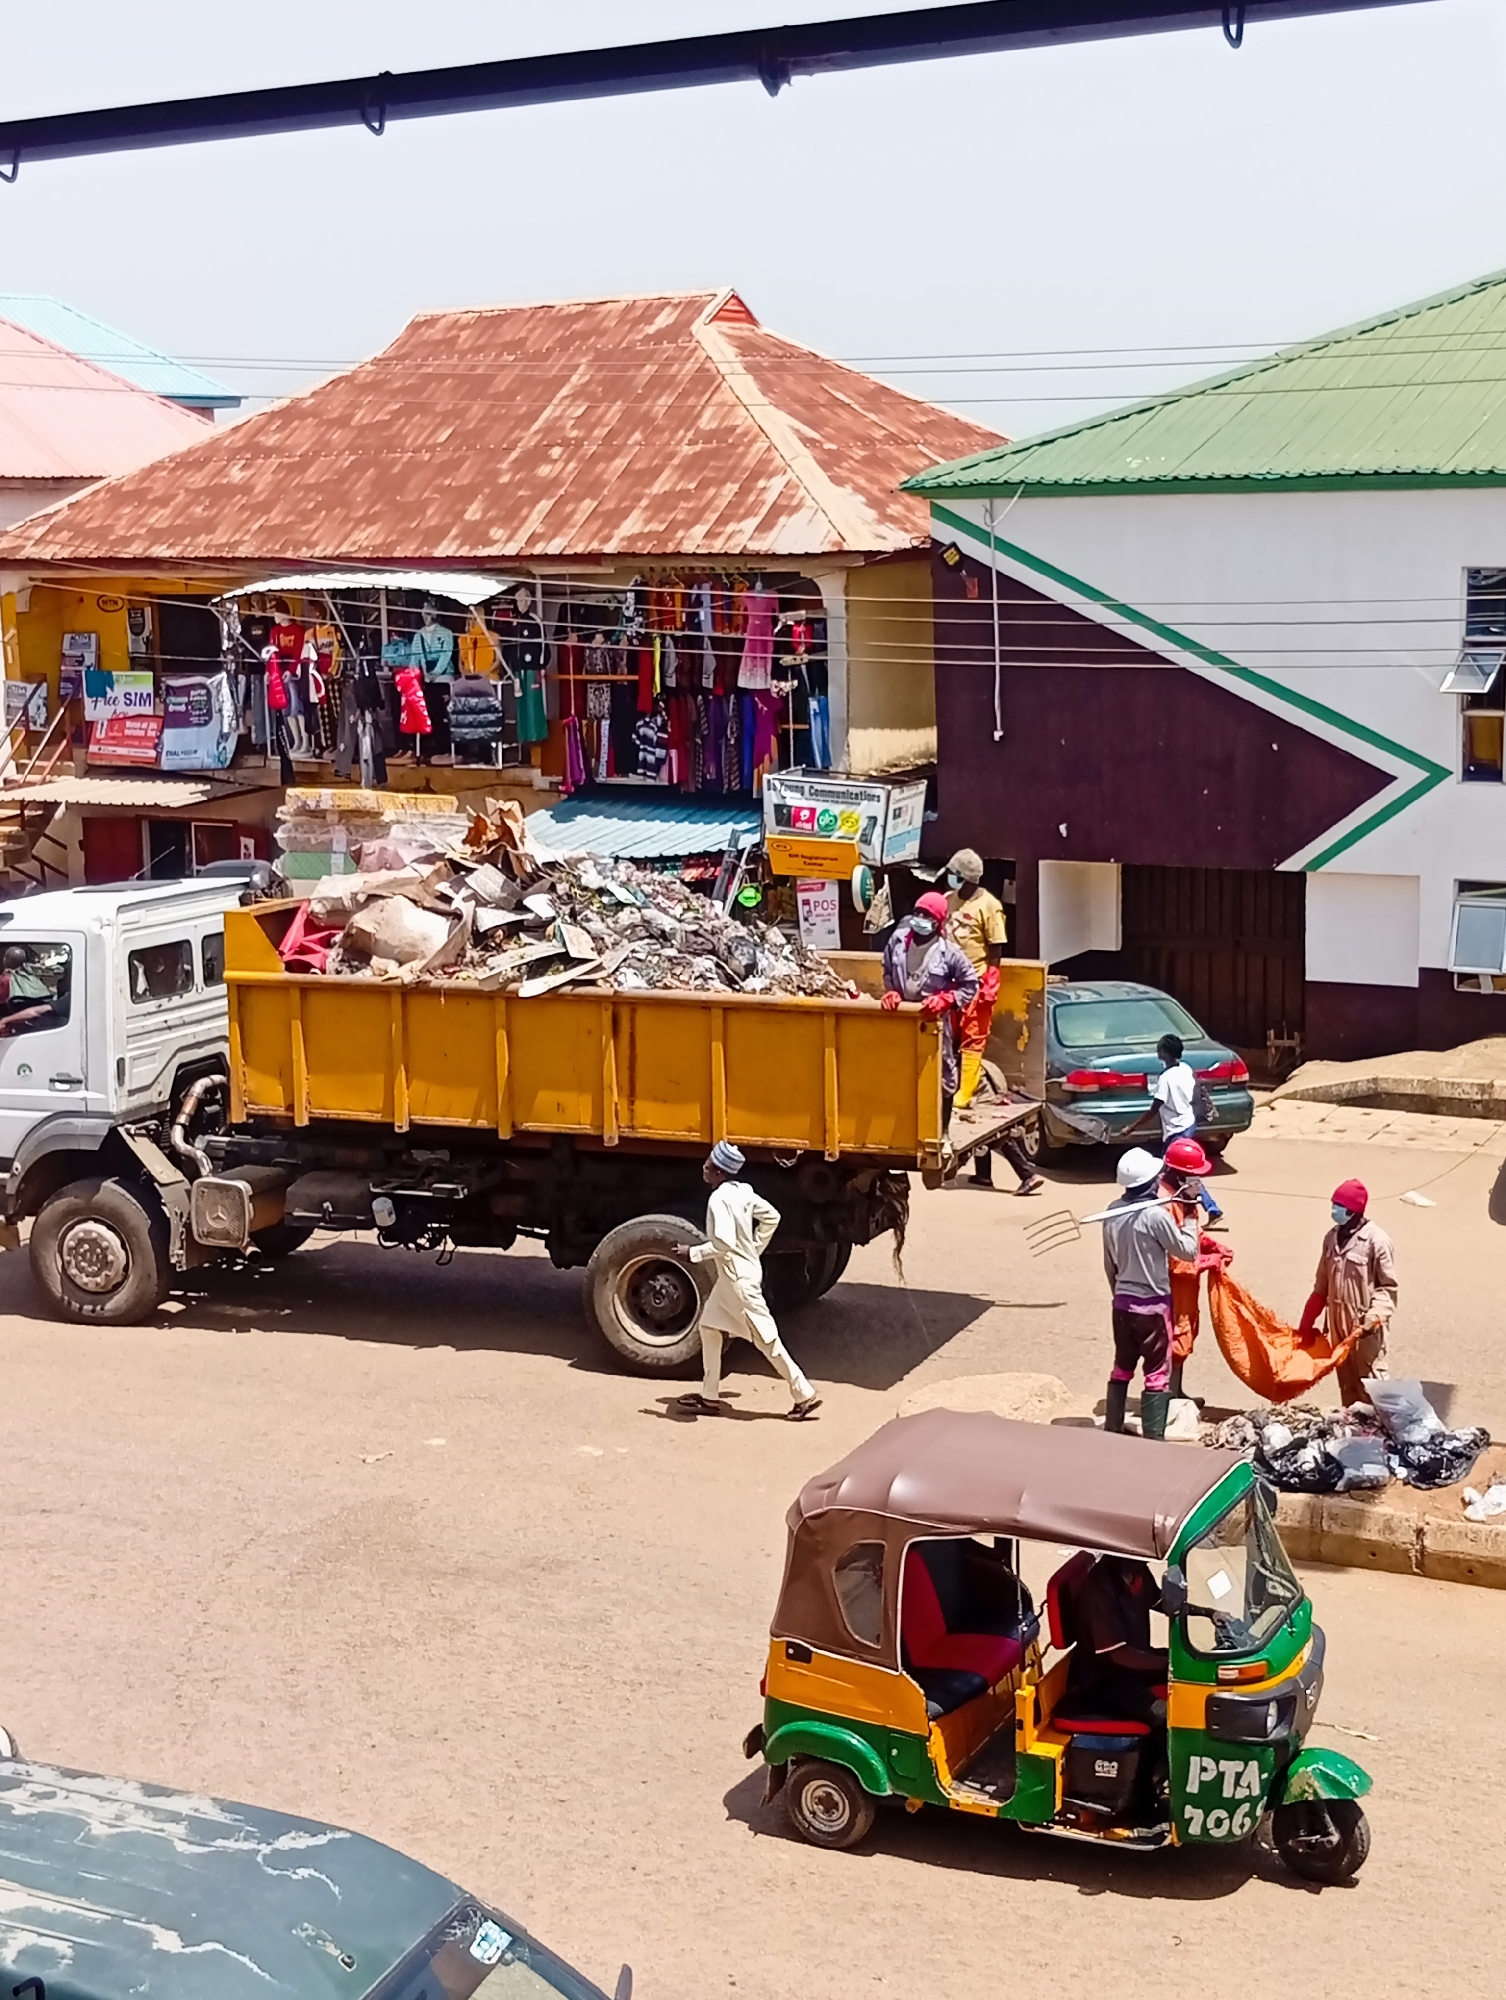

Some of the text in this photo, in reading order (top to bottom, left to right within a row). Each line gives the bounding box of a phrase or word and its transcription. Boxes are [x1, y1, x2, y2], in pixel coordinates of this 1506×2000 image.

[101, 599, 119, 607] MTN
[123, 691, 152, 708] SIM
[808, 785, 881, 803] Communications
[818, 812, 836, 828] glo
[813, 899, 837, 912] POS
